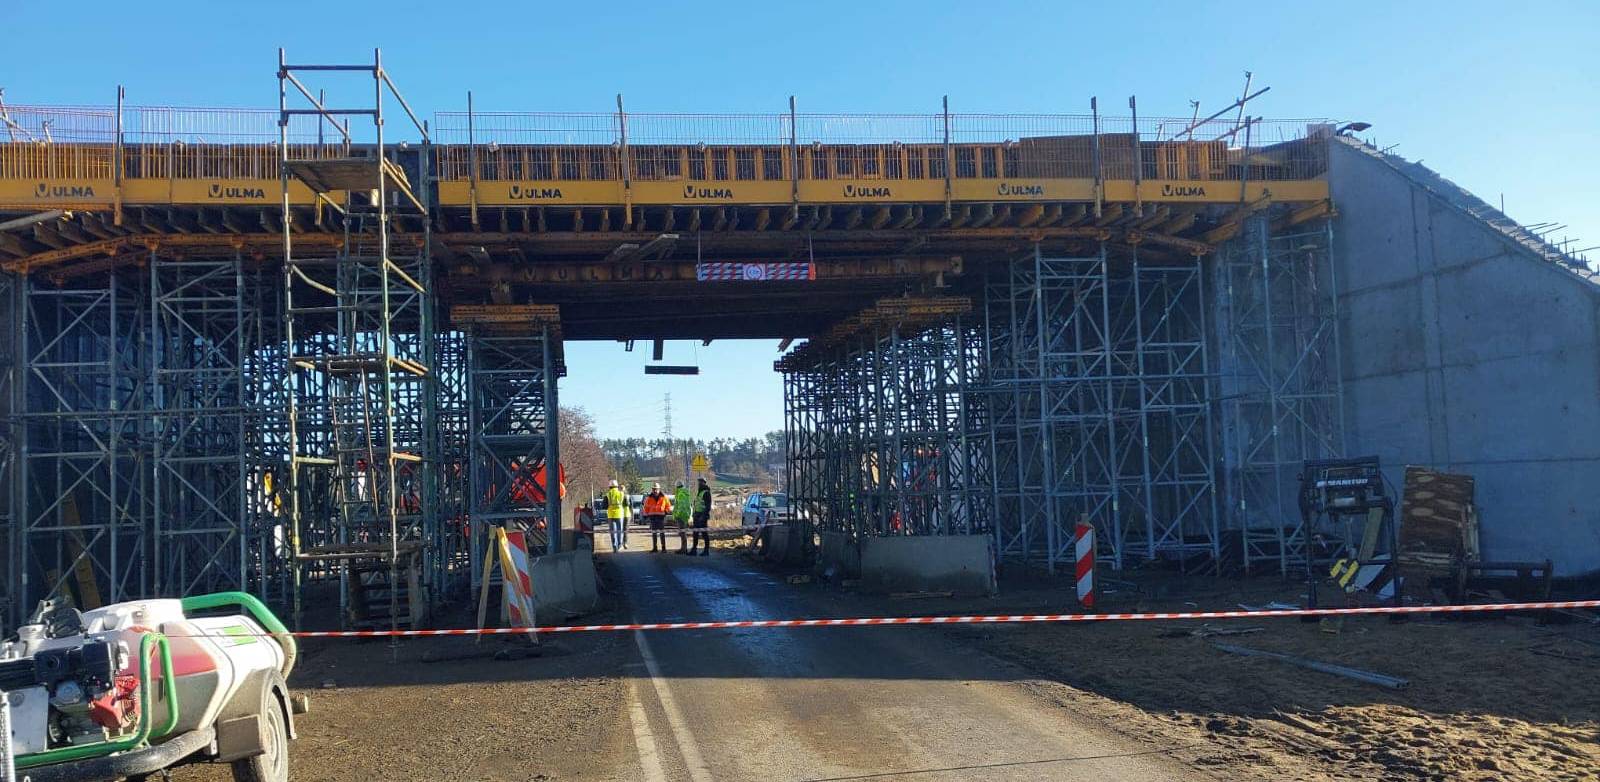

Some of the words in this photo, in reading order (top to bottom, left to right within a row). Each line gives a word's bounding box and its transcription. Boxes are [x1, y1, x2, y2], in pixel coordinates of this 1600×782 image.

[52, 186, 95, 197] ULMA
[226, 187, 265, 199] ULMA
[525, 188, 562, 199] ULMA
[698, 188, 733, 199] ULMA
[857, 187, 891, 198] ULMA
[1012, 186, 1043, 196] ULMA
[1175, 187, 1206, 196] ULMA
